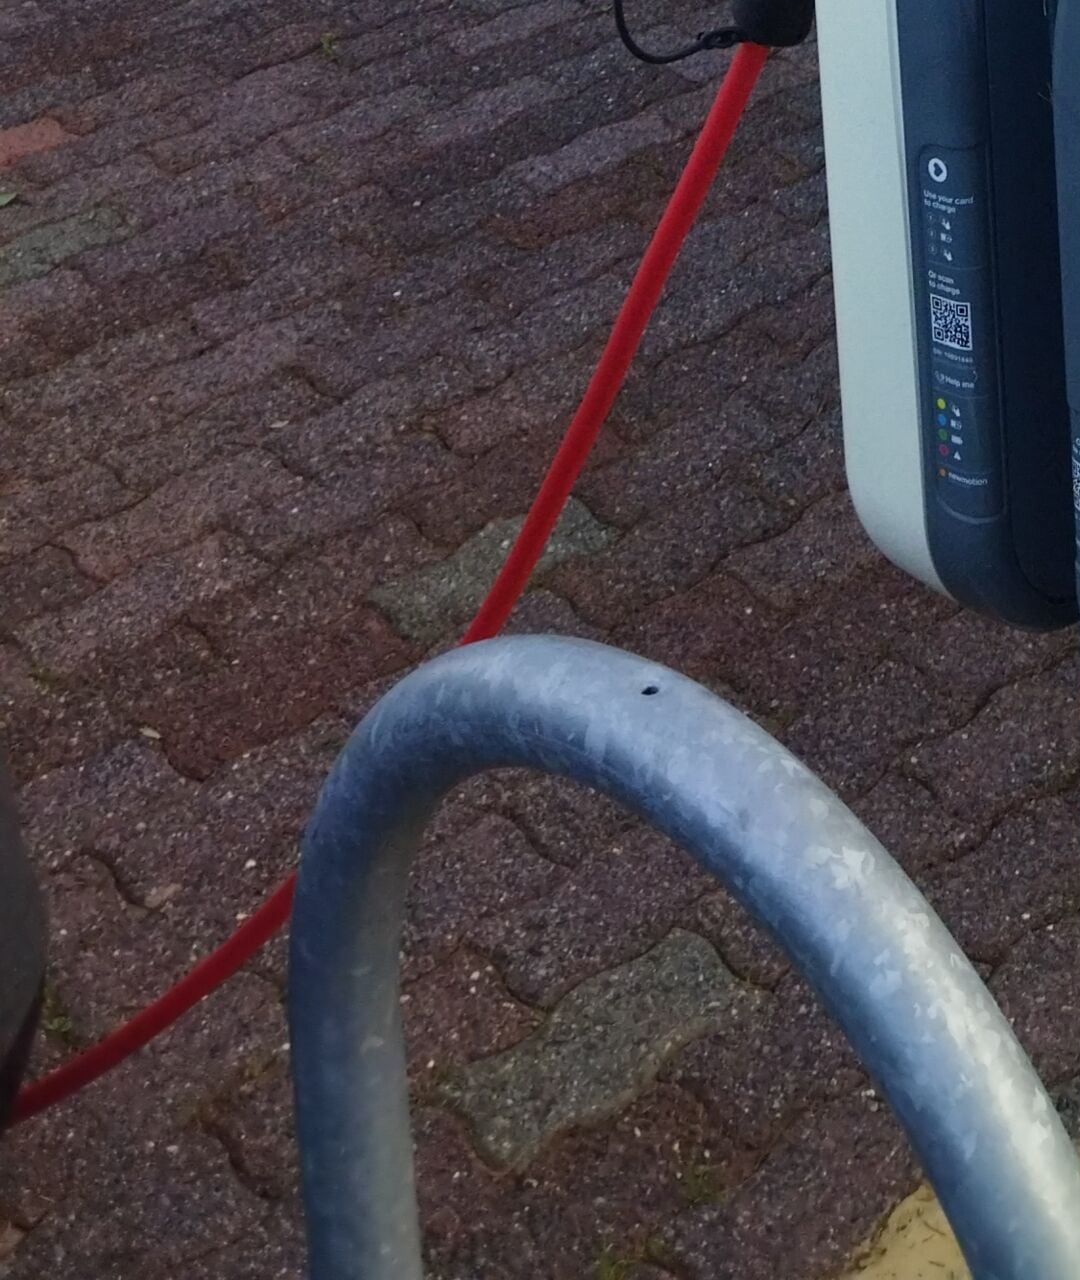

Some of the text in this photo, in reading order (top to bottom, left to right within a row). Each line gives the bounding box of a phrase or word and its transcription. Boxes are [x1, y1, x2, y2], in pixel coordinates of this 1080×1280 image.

[955, 196, 974, 205] card
[932, 201, 956, 213] charge
[948, 471, 988, 486] newmotion
